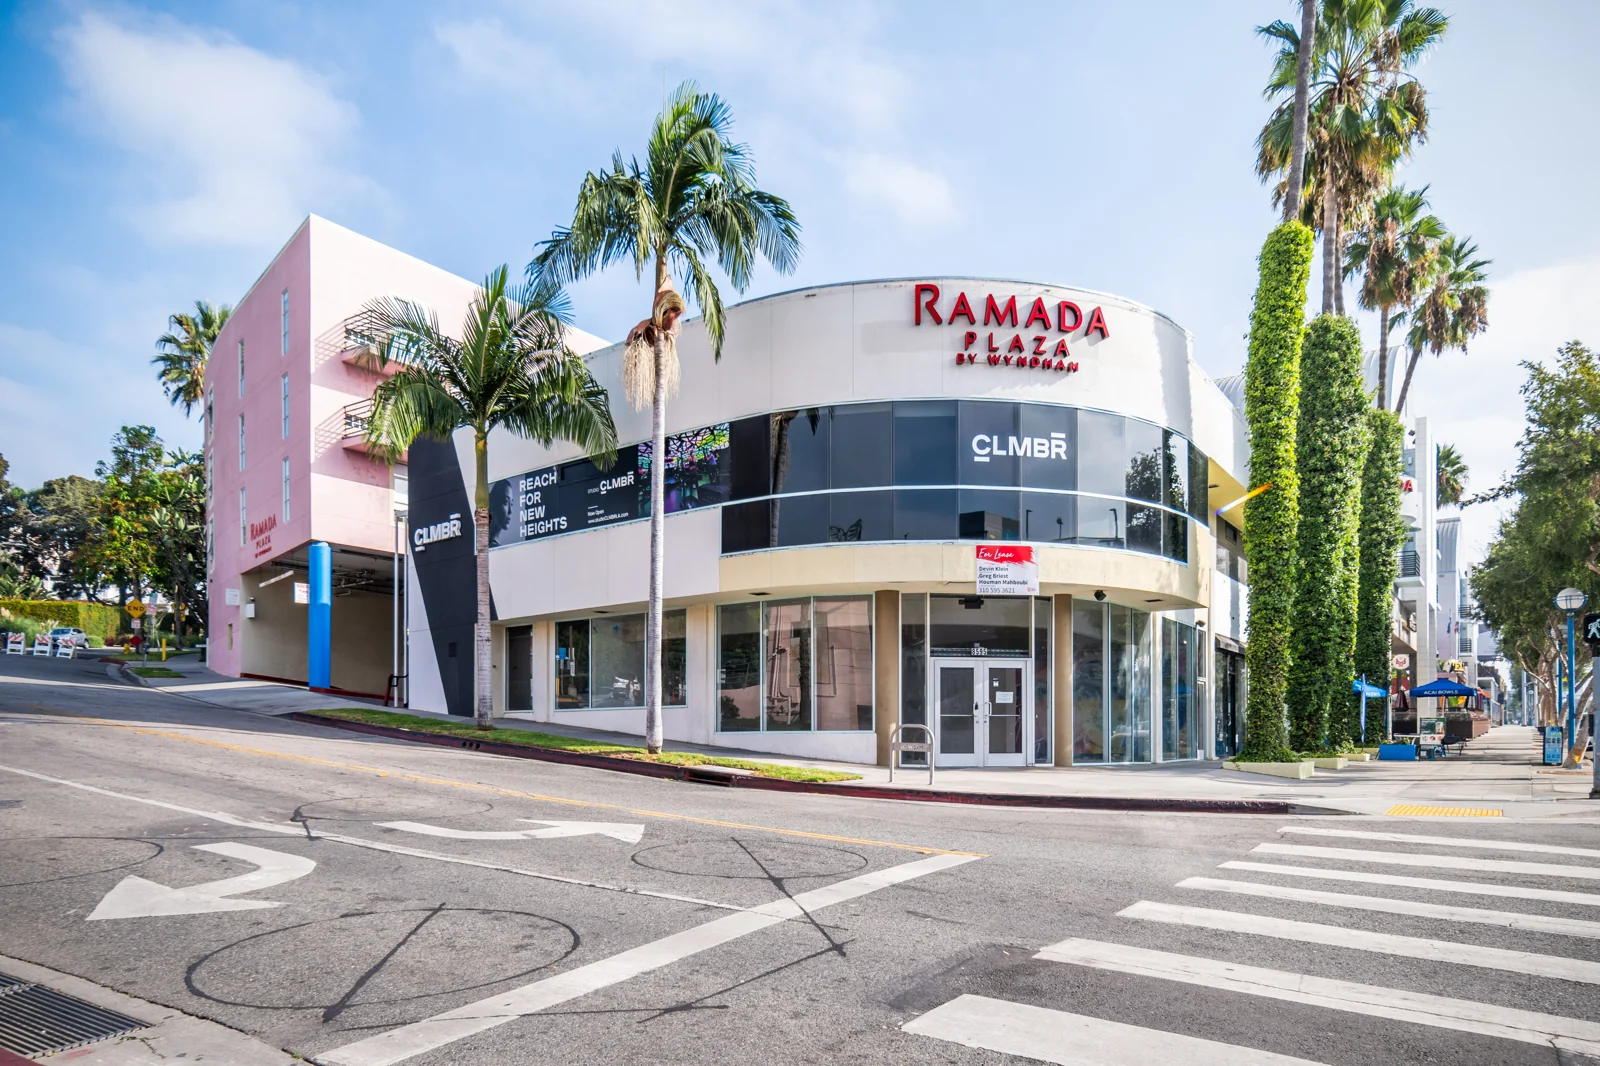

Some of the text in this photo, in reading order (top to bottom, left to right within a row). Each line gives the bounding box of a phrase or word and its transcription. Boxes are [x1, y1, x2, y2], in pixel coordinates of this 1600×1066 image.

[914, 283, 1110, 339] RAMADA
[964, 331, 1070, 357] PLAZA
[956, 352, 1079, 373] BY WYNDHAM
[972, 432, 1068, 462] CLMBR
[519, 471, 558, 492] REACH
[600, 471, 635, 494] CLMBR
[519, 491, 541, 507] FOR
[519, 505, 546, 522] NEW
[250, 513, 277, 541] RAMADA
[413, 513, 462, 551] CLMBR
[519, 516, 568, 538] HEIGHTS
[256, 535, 271, 549] PLAZA
[978, 547, 1015, 560] For Lease
